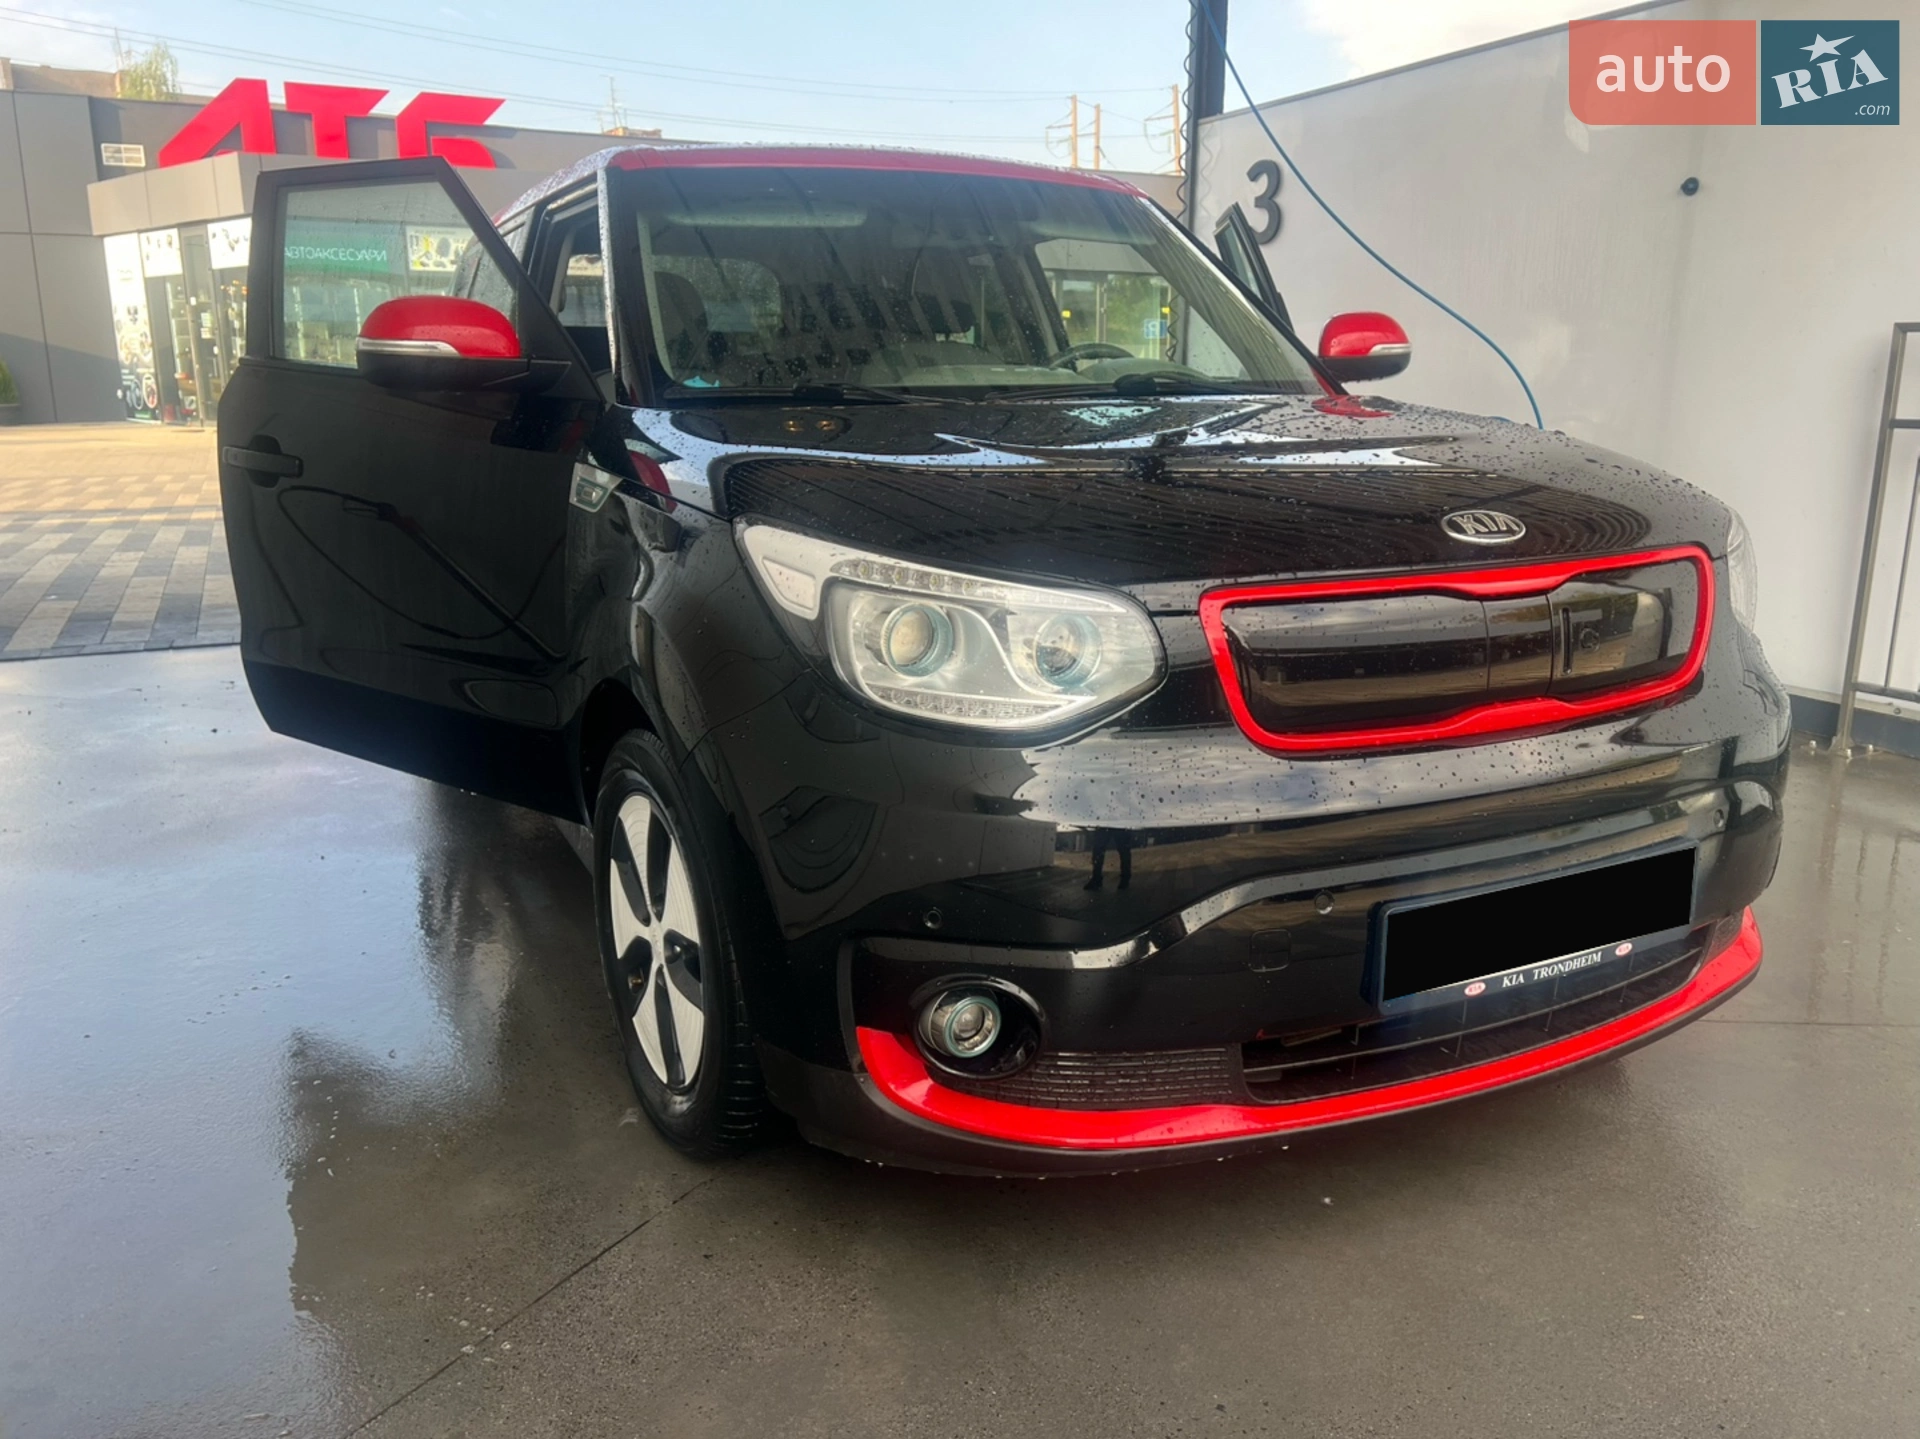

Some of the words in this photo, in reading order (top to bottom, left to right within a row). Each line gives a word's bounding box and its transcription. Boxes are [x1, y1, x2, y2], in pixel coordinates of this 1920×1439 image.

[1246, 159, 1282, 245] 3
[1451, 512, 1520, 535] KIA
[1502, 973, 1525, 987] KIA
[1533, 951, 1602, 980] TRONDHEIM
